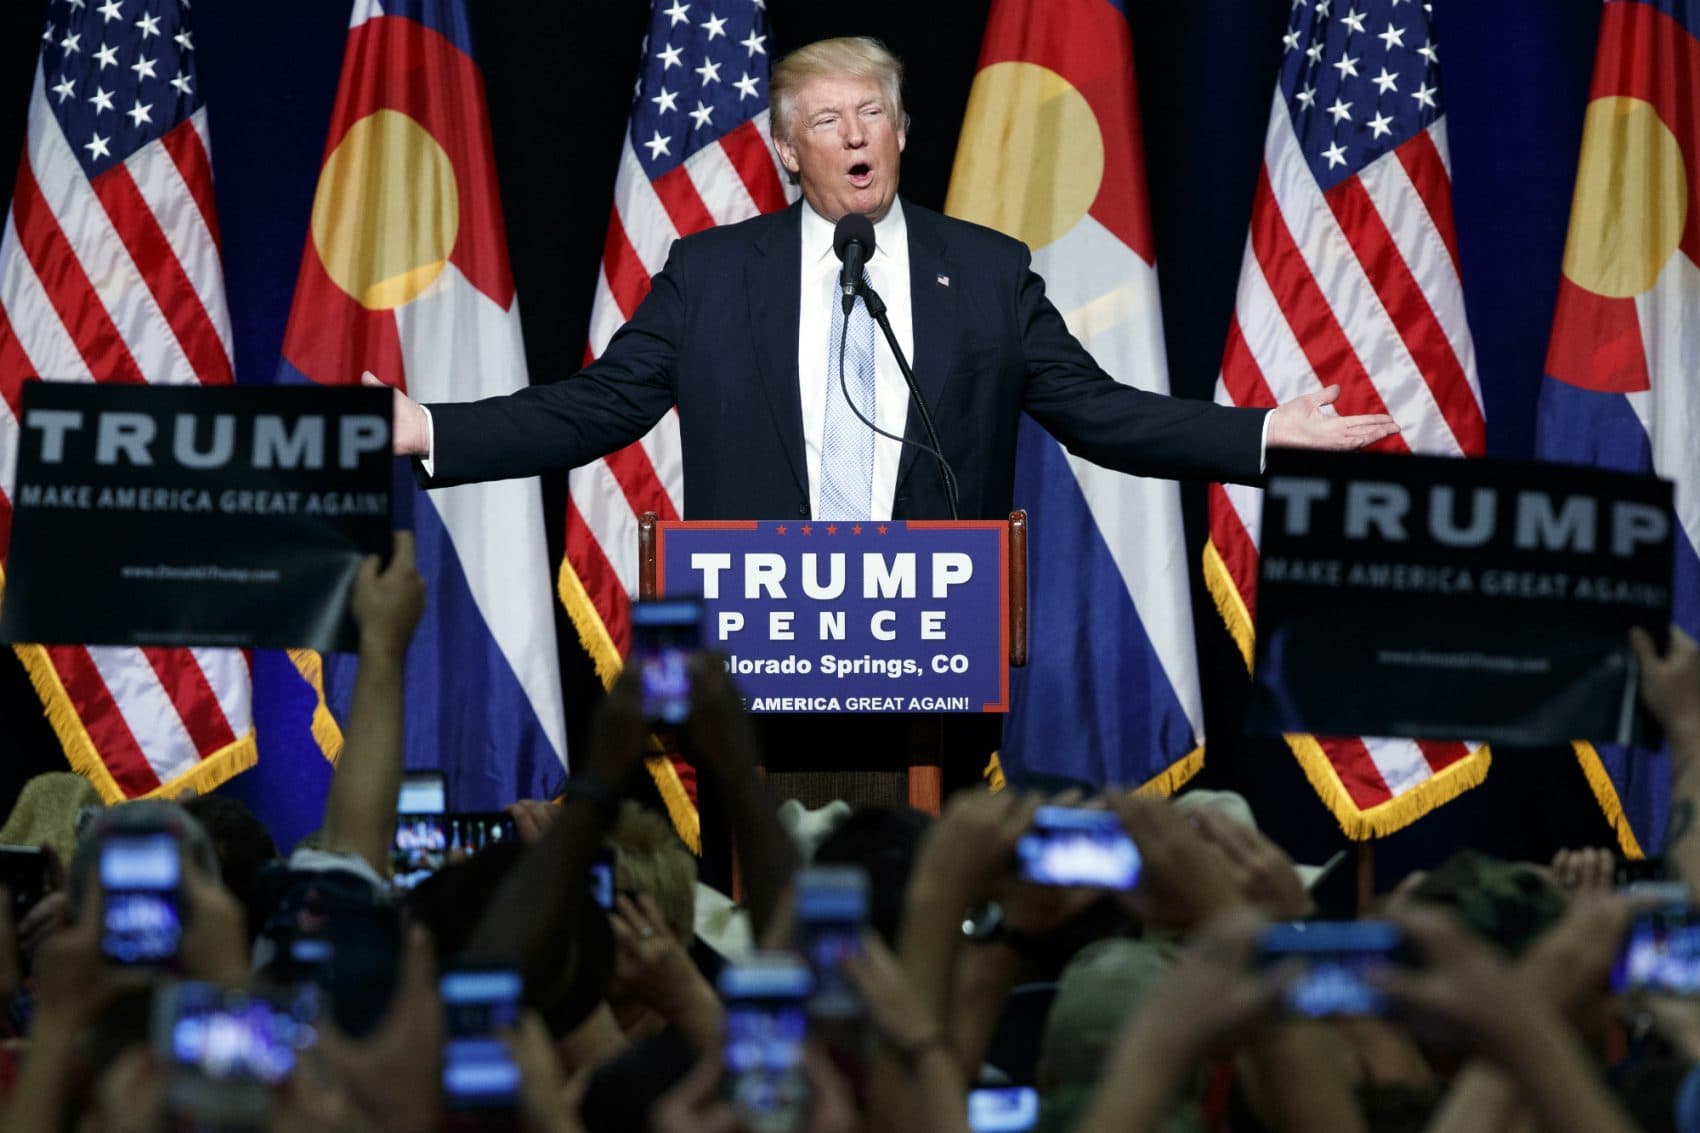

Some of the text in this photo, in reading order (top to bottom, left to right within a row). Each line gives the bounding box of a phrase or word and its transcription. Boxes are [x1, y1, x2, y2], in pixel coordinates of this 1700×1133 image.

[26, 409, 390, 469] TRUMP
[20, 485, 91, 509] MAKE
[97, 487, 213, 512] AMERICA
[219, 490, 297, 514] GREAT
[1268, 477, 1669, 556] TRUMP
[690, 552, 974, 600] TRUMP
[1263, 557, 1342, 586] MAKE
[1348, 562, 1474, 593] AMERICA
[1480, 569, 1568, 598] GREAT
[718, 609, 947, 642] PENCE
[820, 654, 923, 678] Springs,
[931, 654, 969, 674] CO
[751, 697, 841, 711] AMERICA
[845, 697, 904, 711] GREAT
[908, 697, 969, 711] AGAIN!
